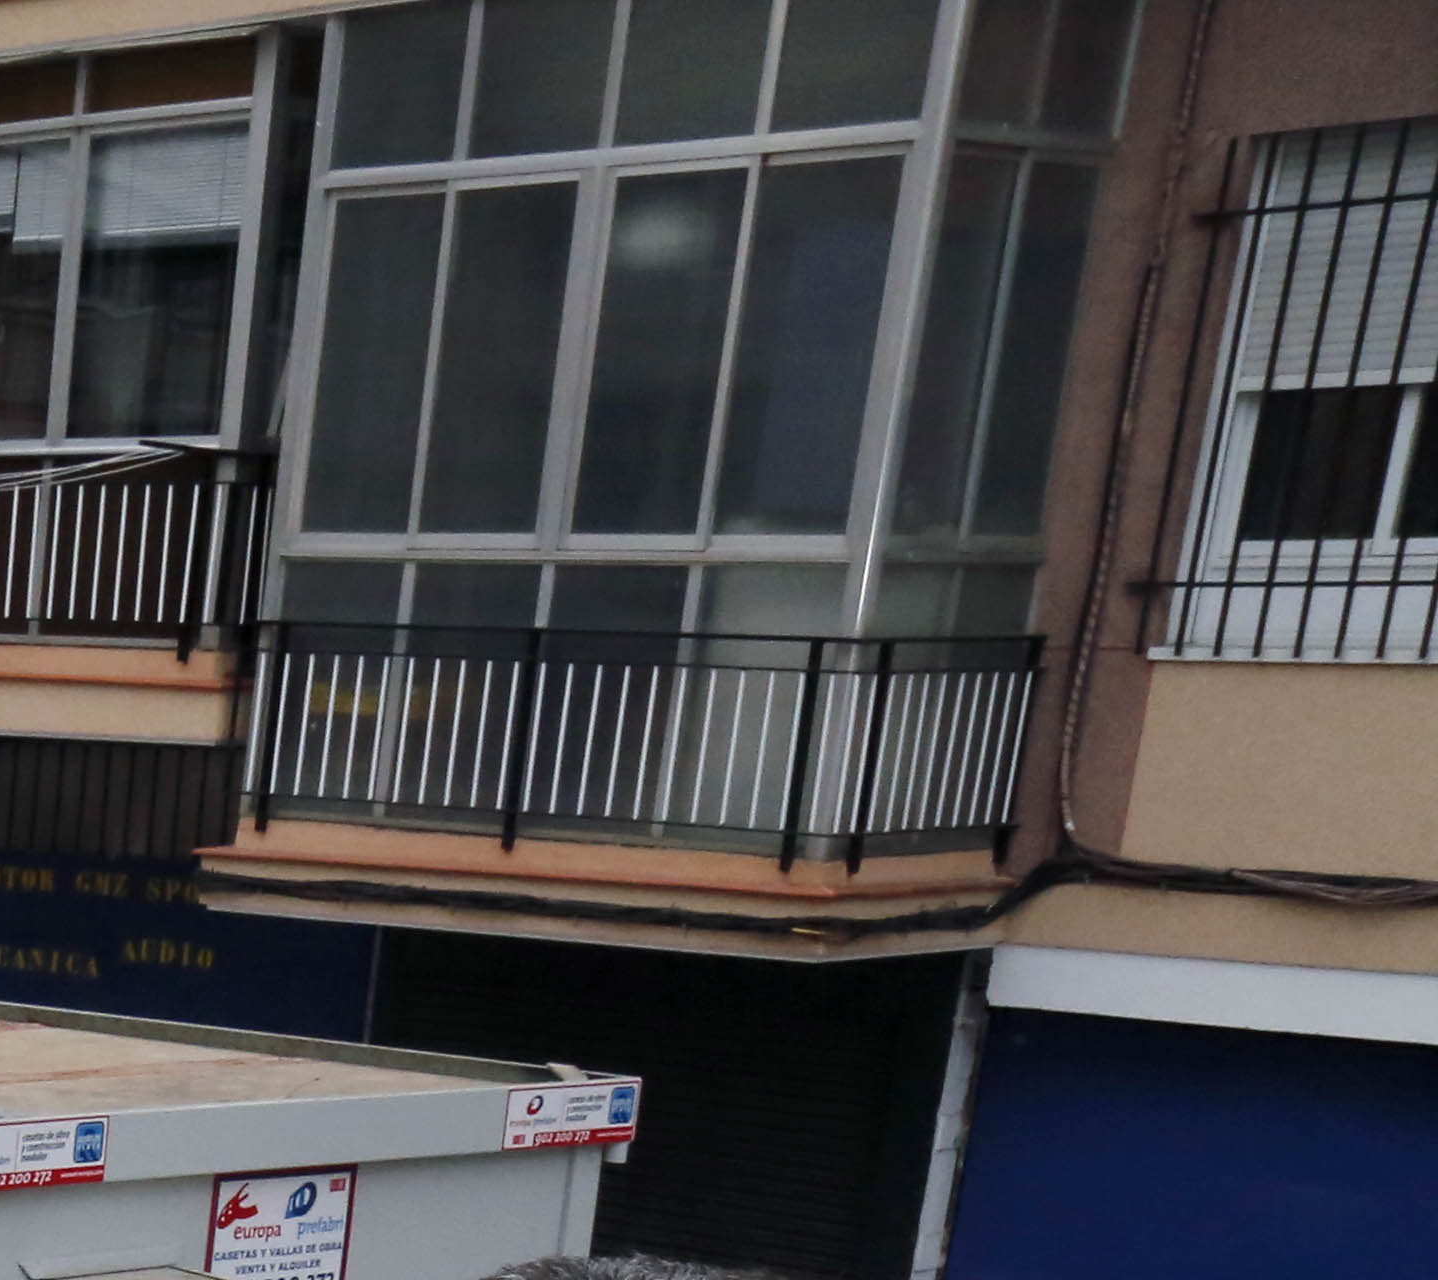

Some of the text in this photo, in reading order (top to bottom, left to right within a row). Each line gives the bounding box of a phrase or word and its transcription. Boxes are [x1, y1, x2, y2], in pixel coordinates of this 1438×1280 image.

[74, 871, 129, 899] GMZ
[122, 937, 215, 969] AUDIO
[534, 1130, 591, 1146] 902 200 272
[8, 1173, 31, 1185] 200
[32, 1170, 52, 1185] 272
[233, 1215, 344, 1243] europa prefabri
[214, 1241, 342, 1262] CASETAS Y VALLAS DE OBRA
[235, 1259, 321, 1275] VENTA Y ALQUILER
